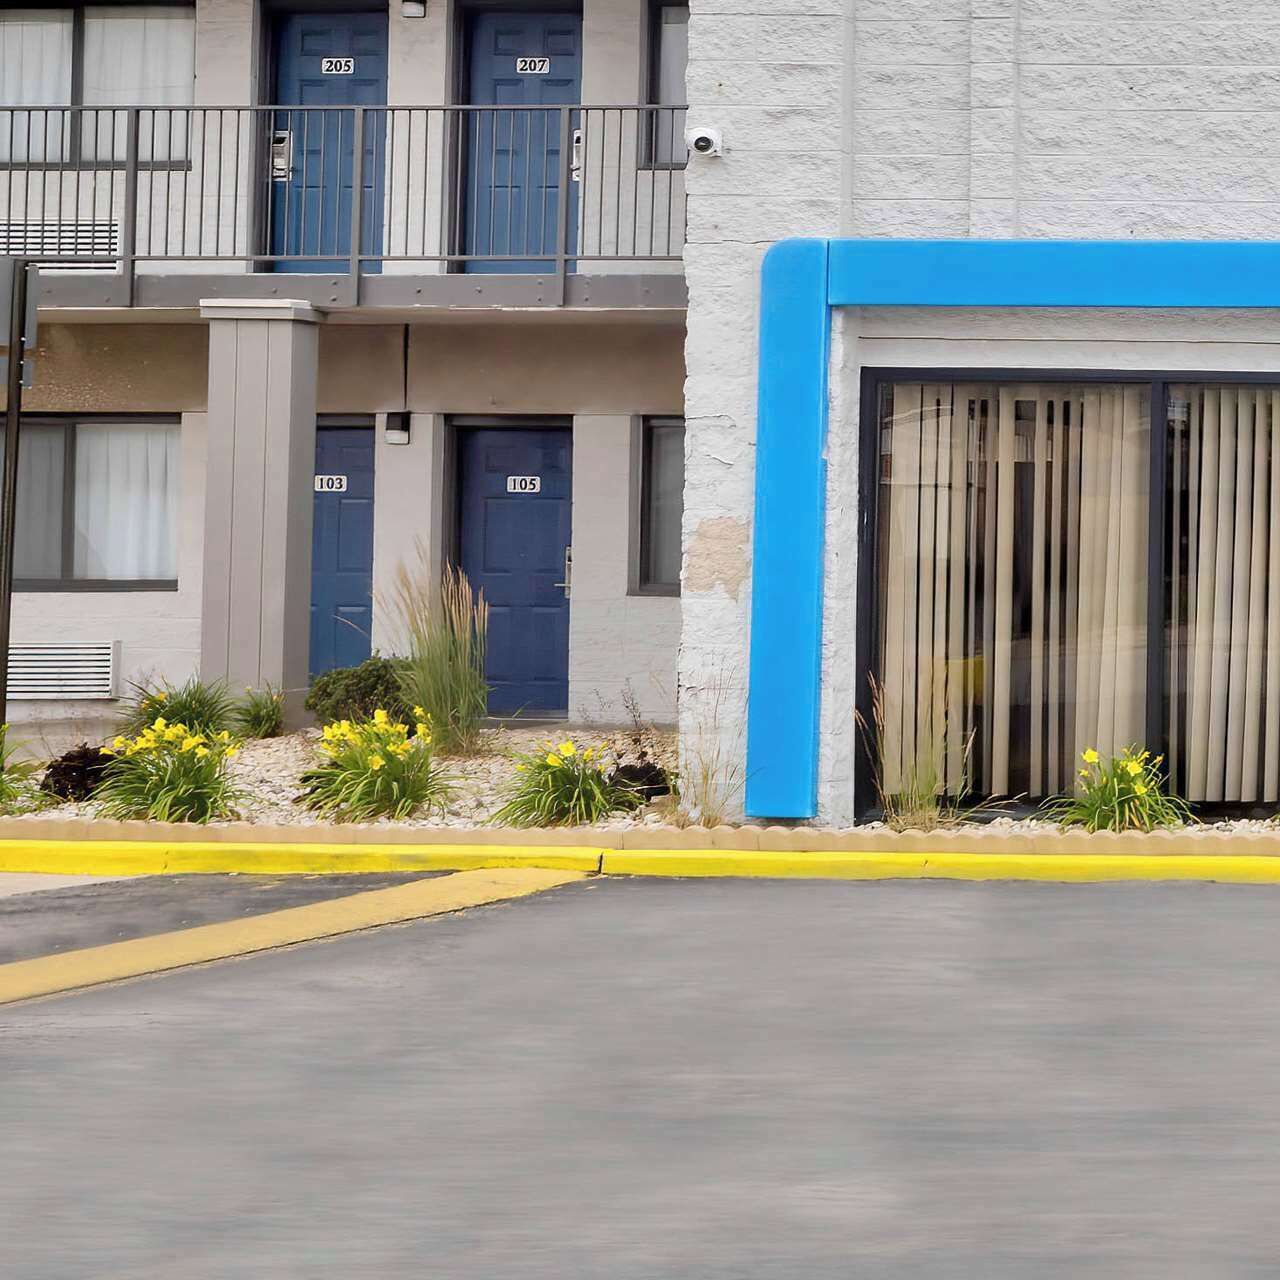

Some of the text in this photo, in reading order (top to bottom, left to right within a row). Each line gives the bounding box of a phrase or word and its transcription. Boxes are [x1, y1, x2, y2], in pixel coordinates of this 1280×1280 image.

[325, 60, 352, 72] 205
[519, 60, 547, 72] 207
[319, 477, 343, 490] 103
[512, 478, 536, 491] 105
